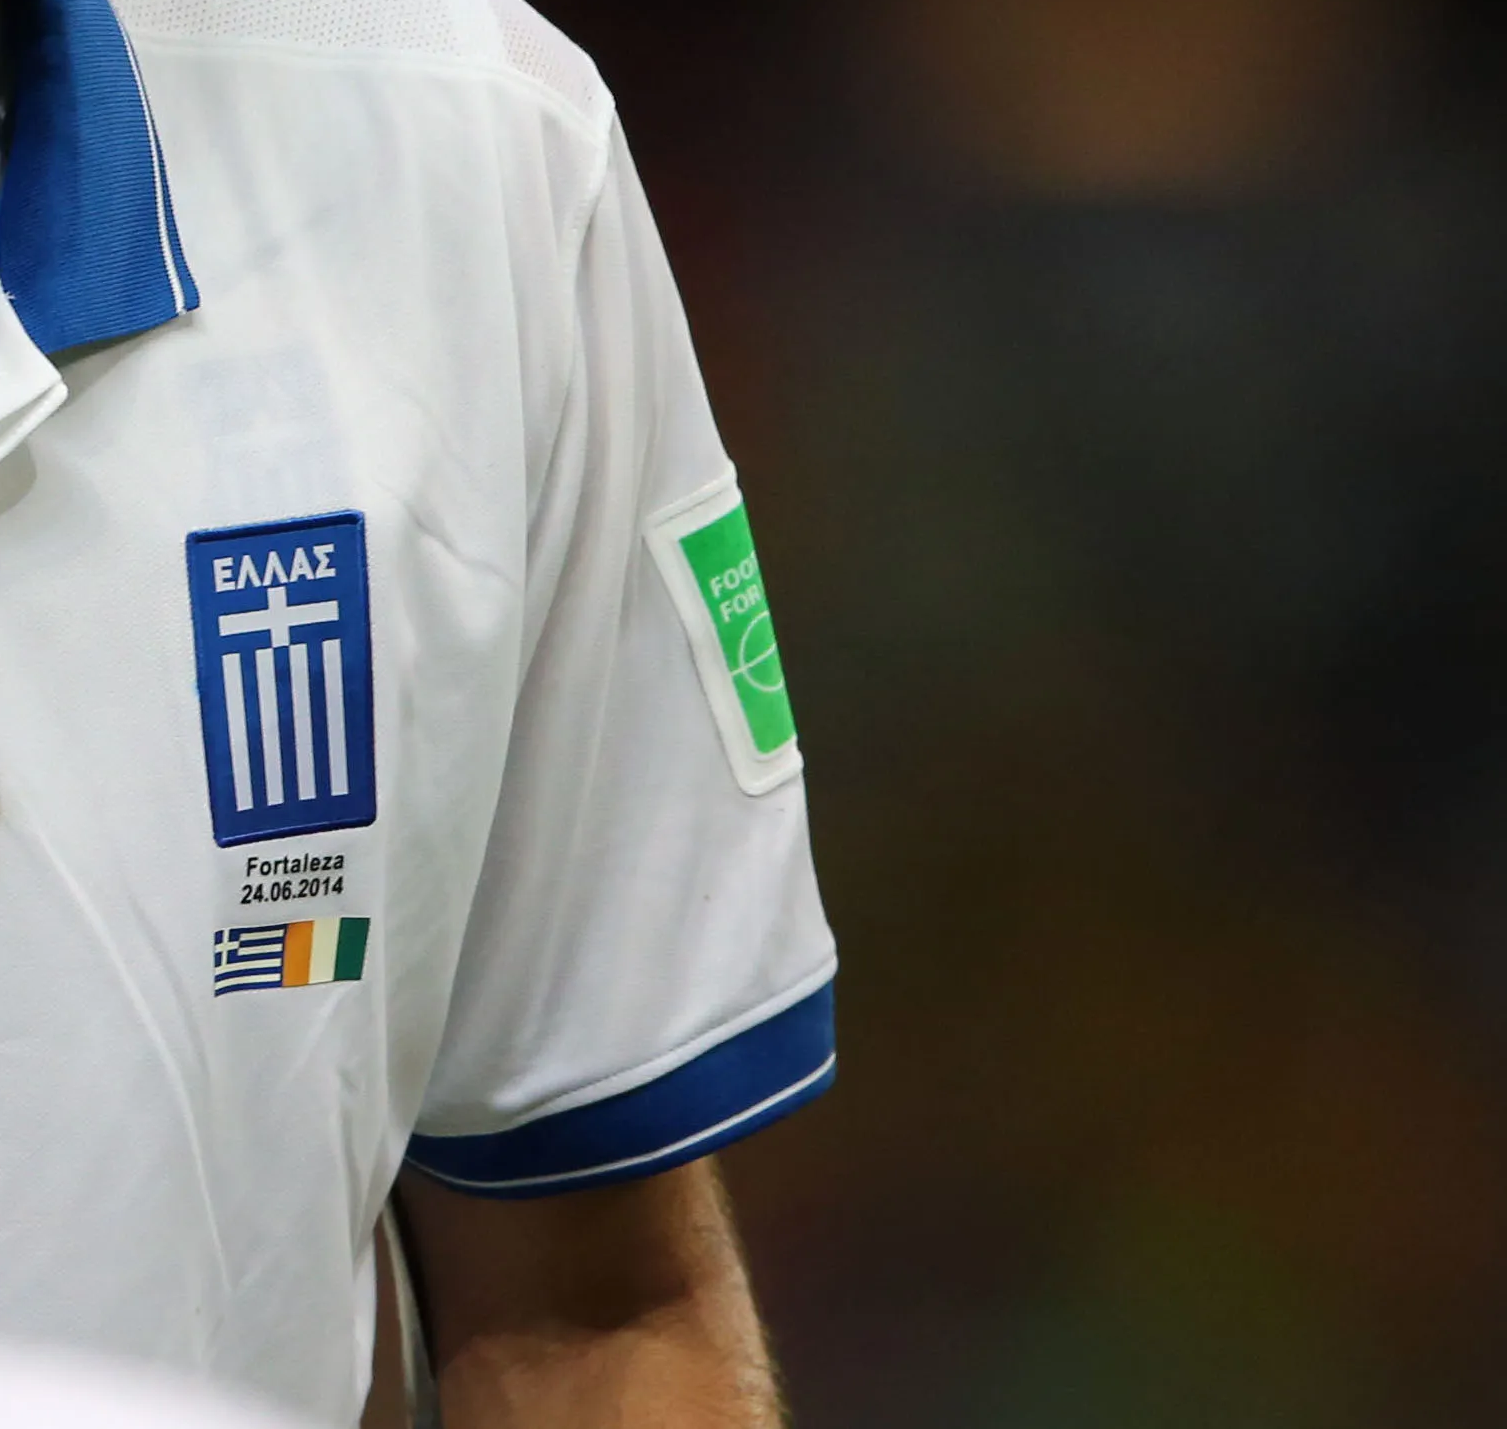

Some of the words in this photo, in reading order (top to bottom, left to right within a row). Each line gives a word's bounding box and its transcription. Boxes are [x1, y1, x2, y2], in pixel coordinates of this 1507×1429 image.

[212, 544, 337, 593] ΕΛΛΑΣ
[719, 583, 762, 622] FOR
[245, 852, 345, 878] Fortaleza
[240, 877, 344, 905] 24.06.2014
